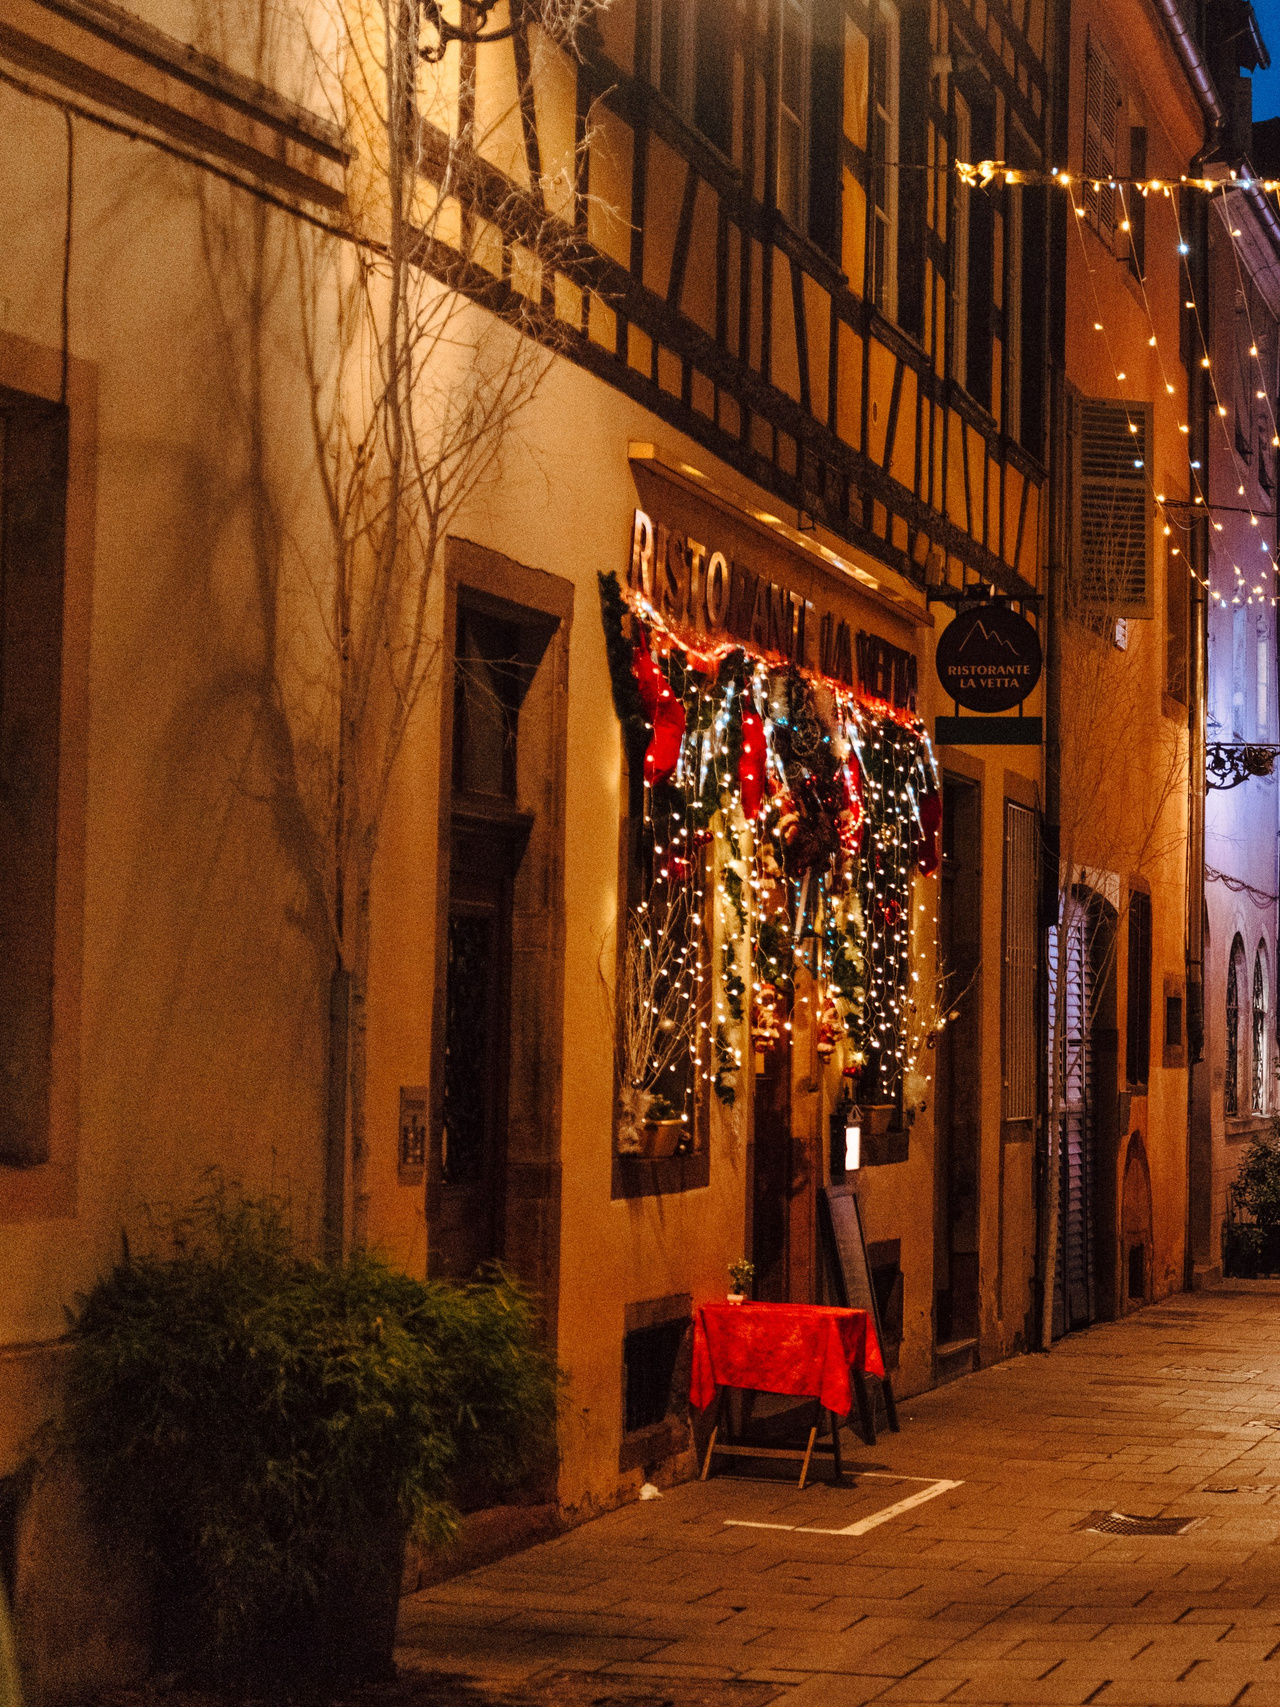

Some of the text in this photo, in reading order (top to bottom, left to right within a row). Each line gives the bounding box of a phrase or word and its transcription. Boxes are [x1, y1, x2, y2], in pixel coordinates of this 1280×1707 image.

[948, 664, 1031, 676] RISTORANTE
[960, 678, 1020, 689] LA VETTA
